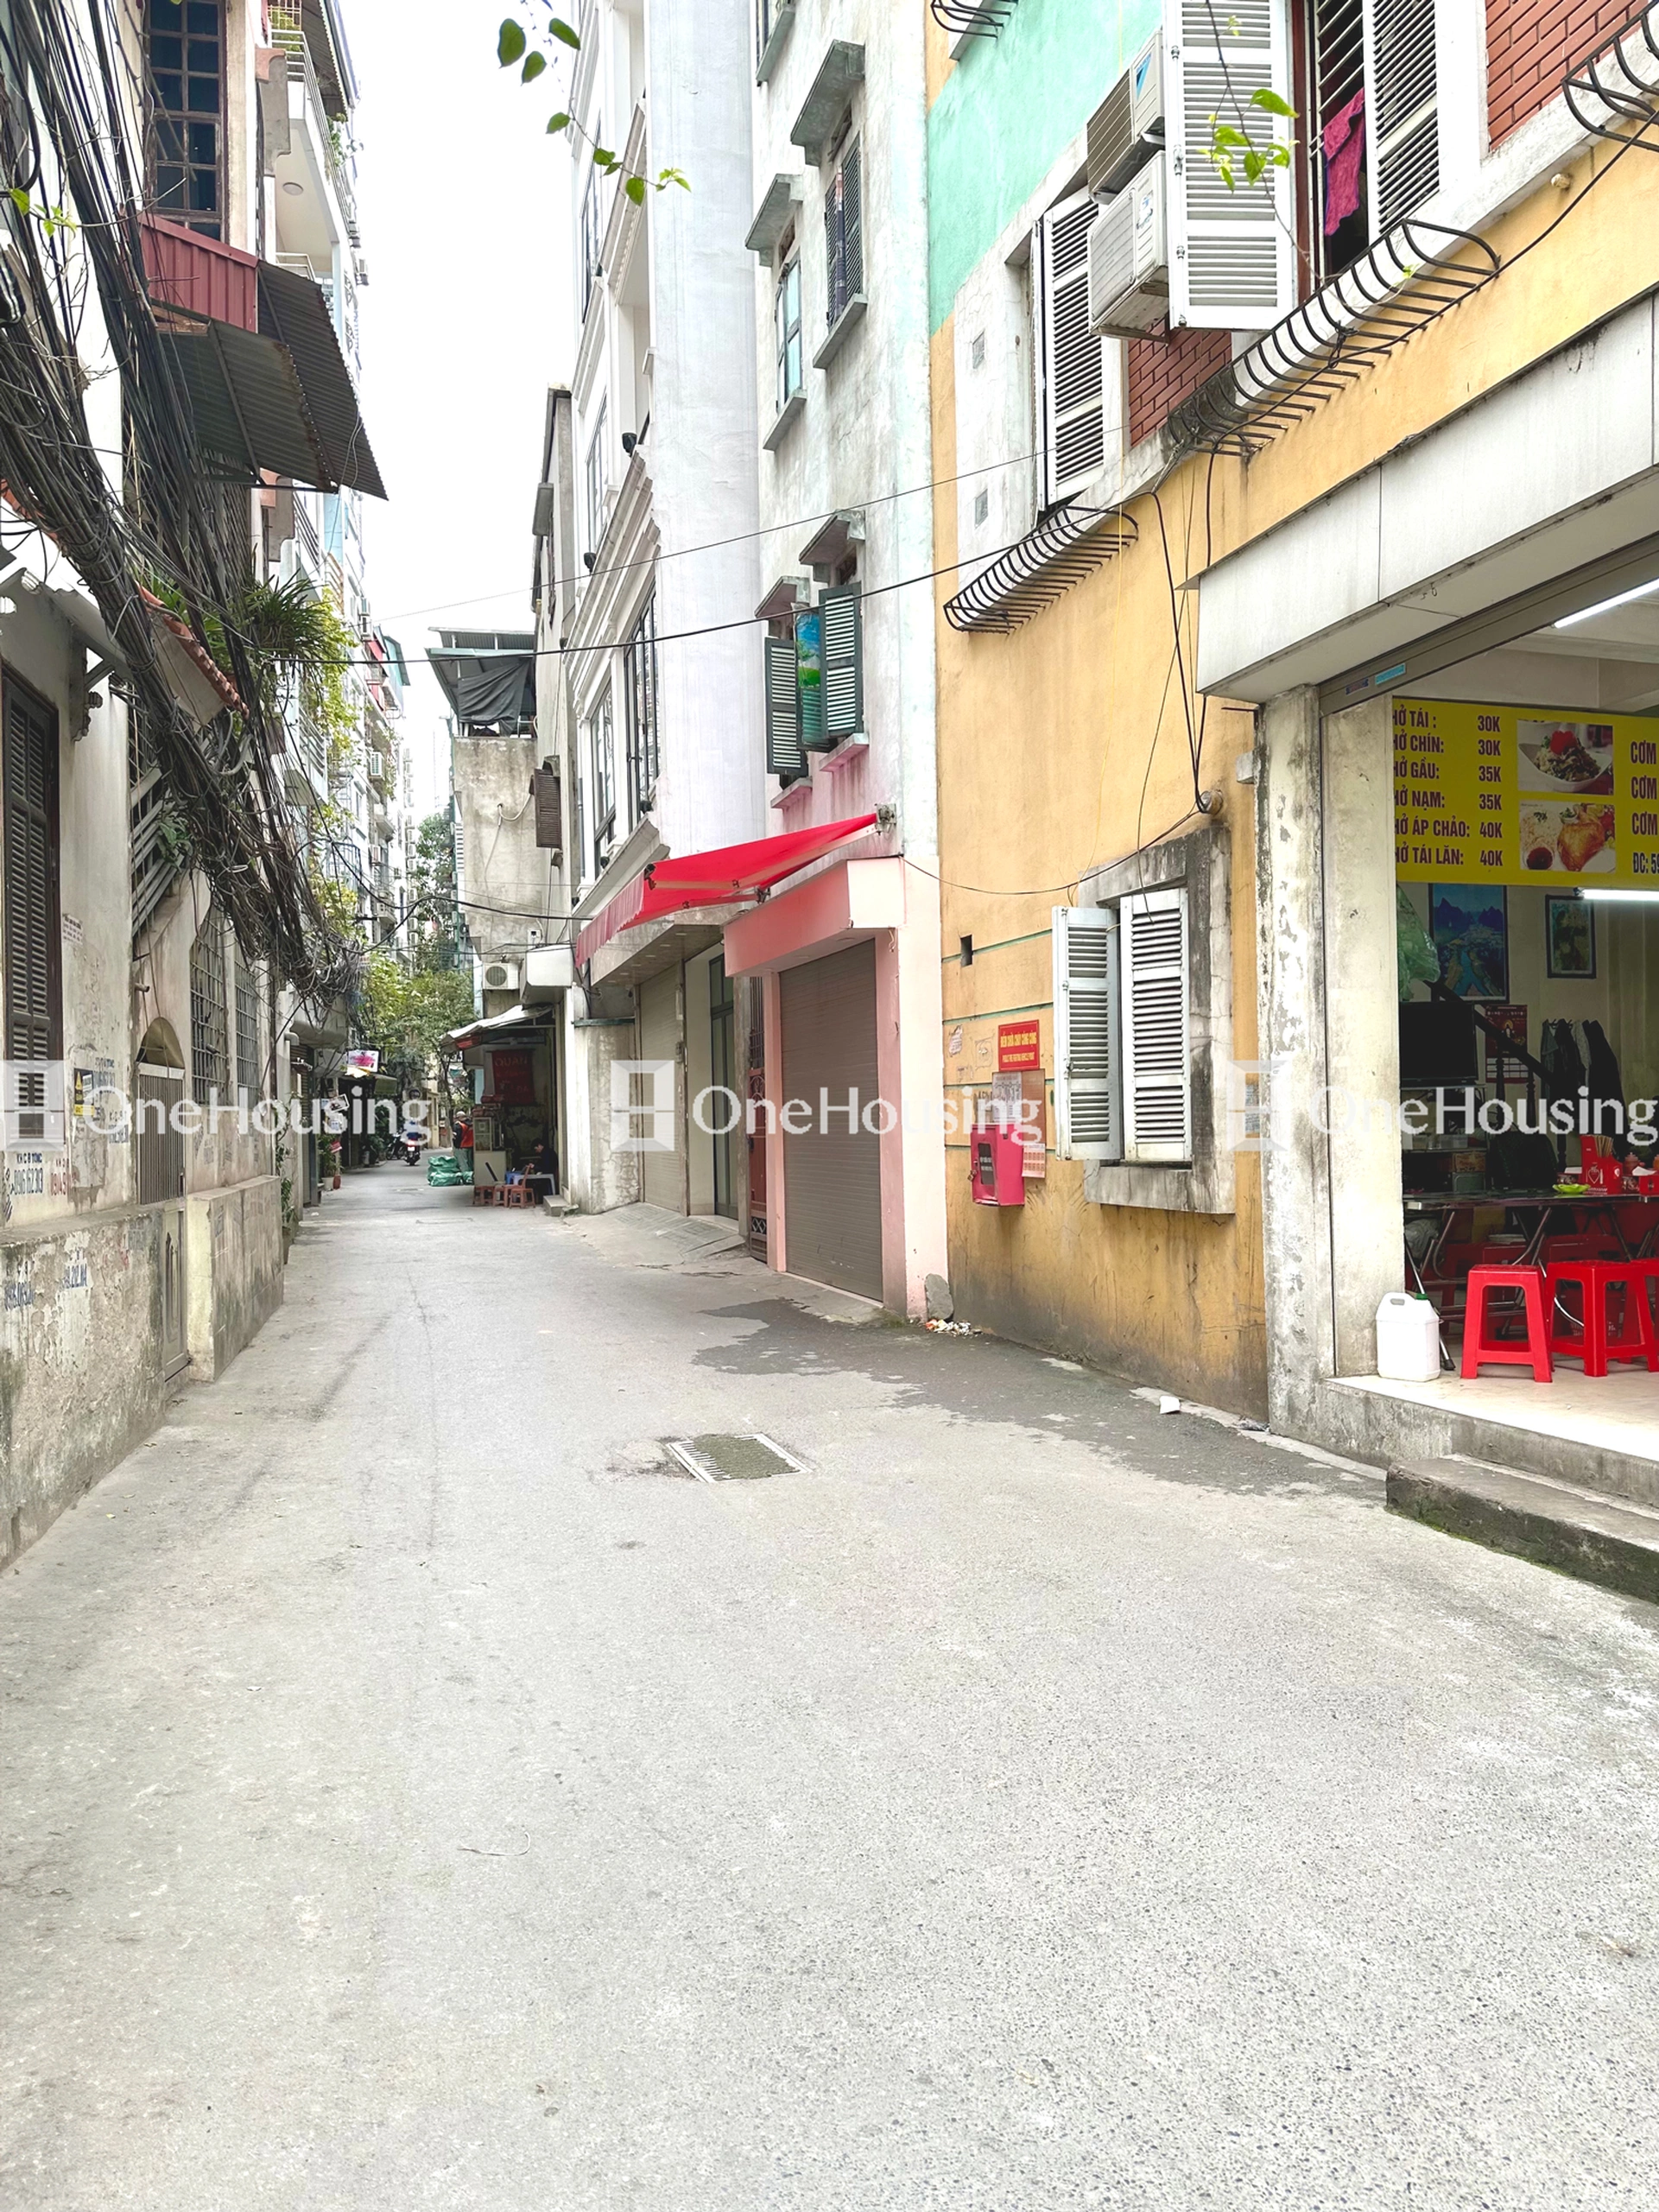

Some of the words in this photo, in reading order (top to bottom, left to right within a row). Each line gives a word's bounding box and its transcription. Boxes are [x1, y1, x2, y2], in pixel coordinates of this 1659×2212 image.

[1393, 704, 1407, 726] HỞ
[1409, 707, 1428, 728] TÁI
[1478, 715, 1501, 732] 30K
[1394, 729, 1407, 751] HỞ
[1410, 732, 1444, 753] CHÍN:
[1478, 739, 1501, 756] 30K
[1631, 740, 1656, 764] CƠM
[1394, 756, 1408, 777] HỞ
[1410, 757, 1440, 779] GẦU:
[1479, 765, 1502, 783] 35K
[1394, 784, 1408, 807] HỞ
[1412, 790, 1445, 811] NẠM:
[1631, 775, 1657, 800] CƠM
[1479, 794, 1502, 810] 35K
[1395, 813, 1409, 835] HỞ
[1412, 815, 1428, 835] ÁP
[1434, 815, 1470, 838] CHẢO:
[1479, 821, 1503, 839] 40K
[1632, 811, 1657, 835] CƠM
[1396, 841, 1409, 864] HỞ
[1412, 844, 1432, 864] TÁI
[1436, 845, 1464, 865] LĂN:
[1479, 850, 1503, 866] 40K
[1633, 852, 1649, 873] ĐC:
